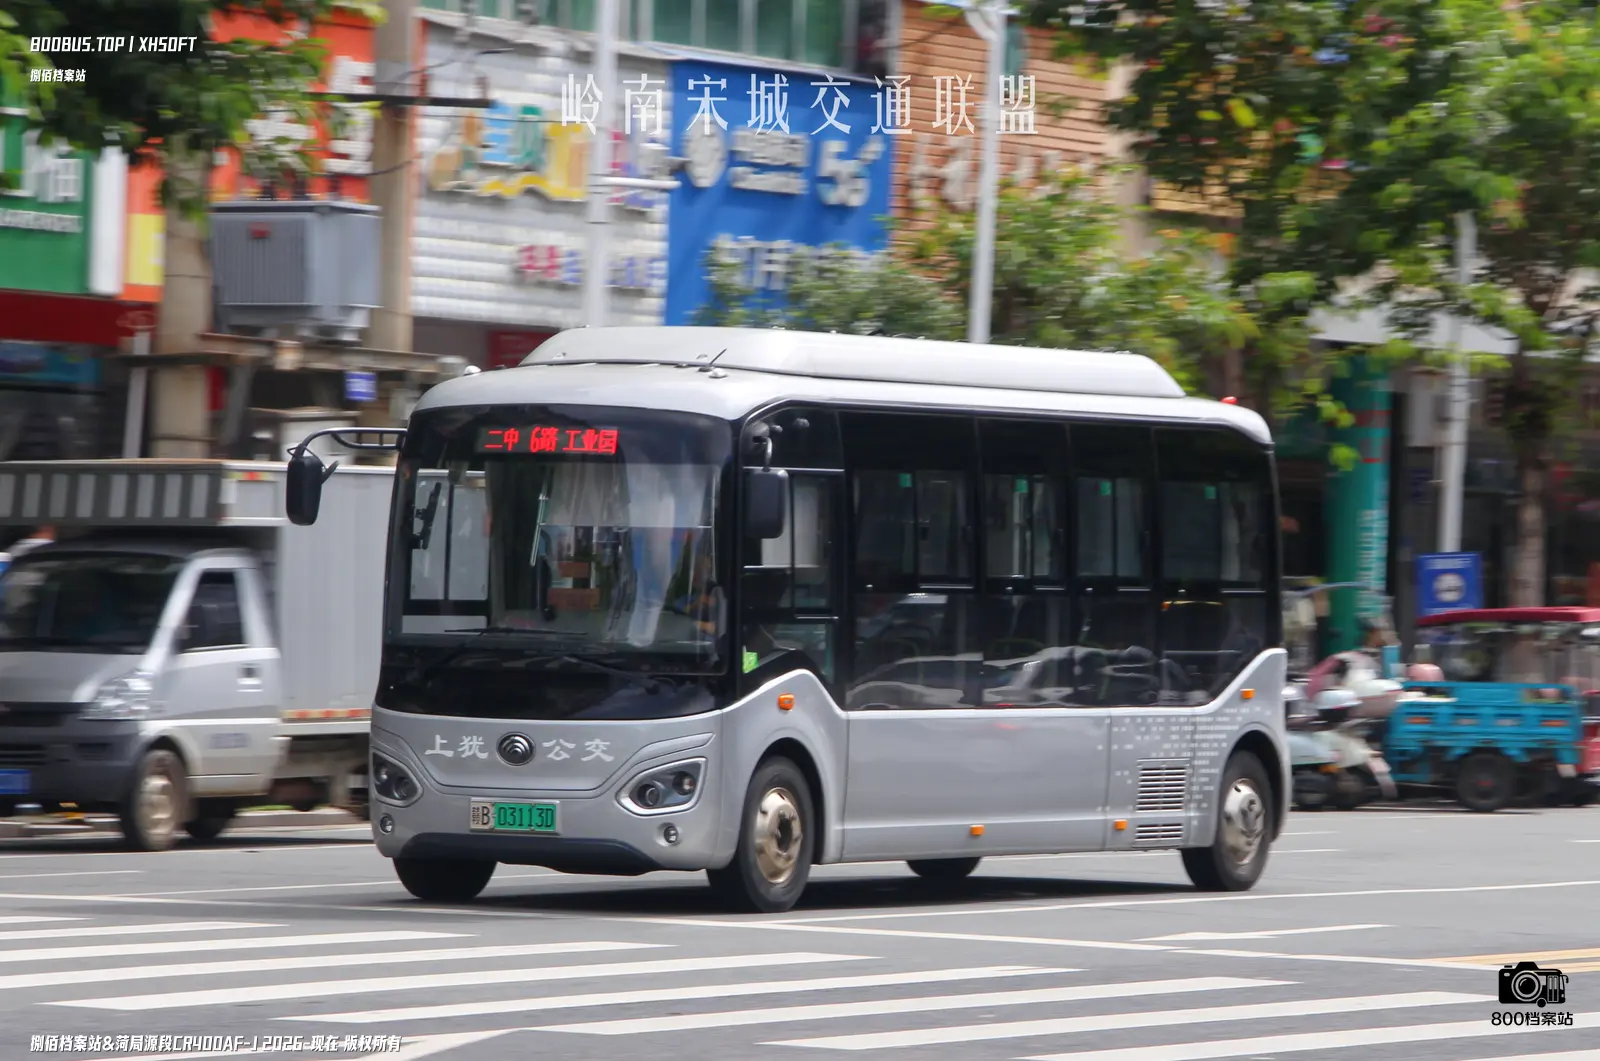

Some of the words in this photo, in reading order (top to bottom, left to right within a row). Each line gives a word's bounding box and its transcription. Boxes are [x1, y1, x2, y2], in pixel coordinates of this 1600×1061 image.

[484, 427, 521, 452] 二中
[529, 426, 559, 453] 6路
[562, 428, 619, 454] 工业园
[424, 734, 490, 759] 上犹
[541, 737, 615, 763] 公交
